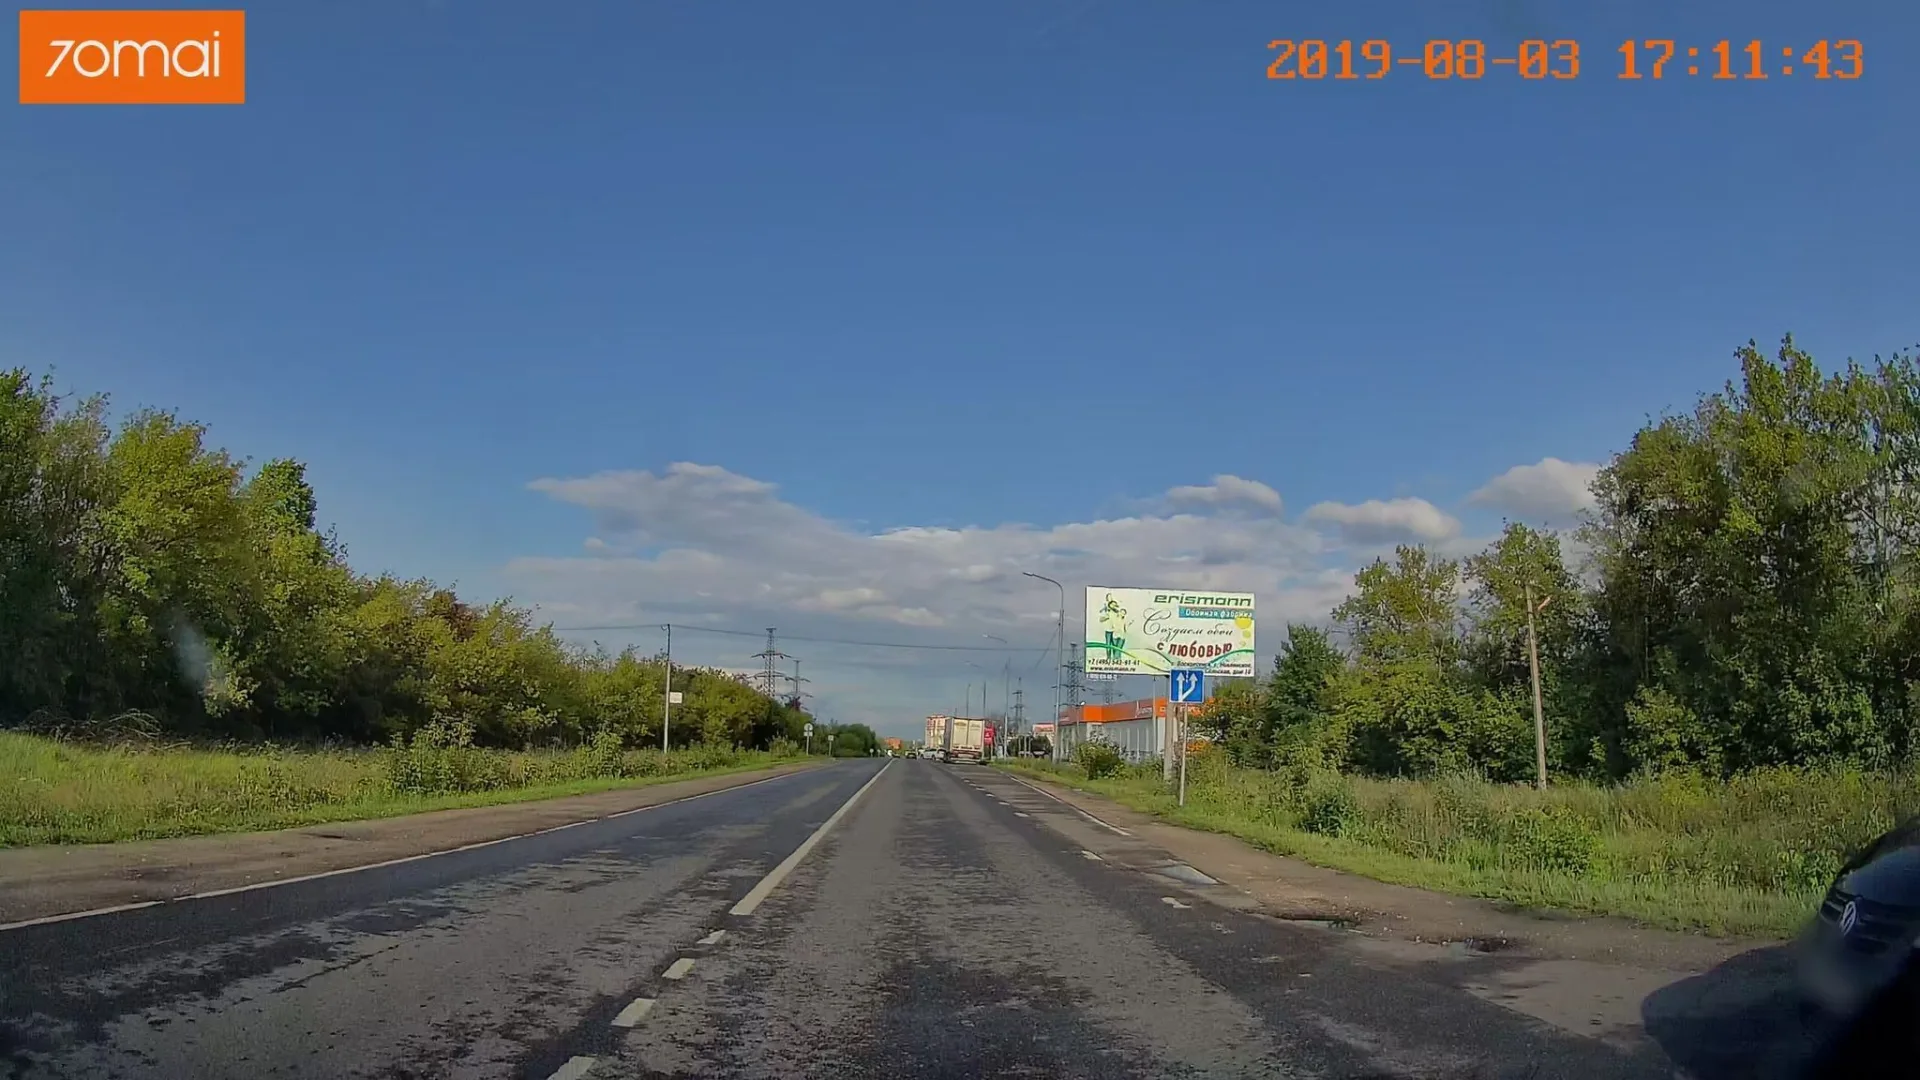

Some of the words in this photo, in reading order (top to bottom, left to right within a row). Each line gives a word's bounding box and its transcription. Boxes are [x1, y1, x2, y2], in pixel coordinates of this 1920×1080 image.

[1154, 593, 1252, 607] erismann
[1207, 623, 1233, 636] обои
[1168, 640, 1233, 658] любовью
